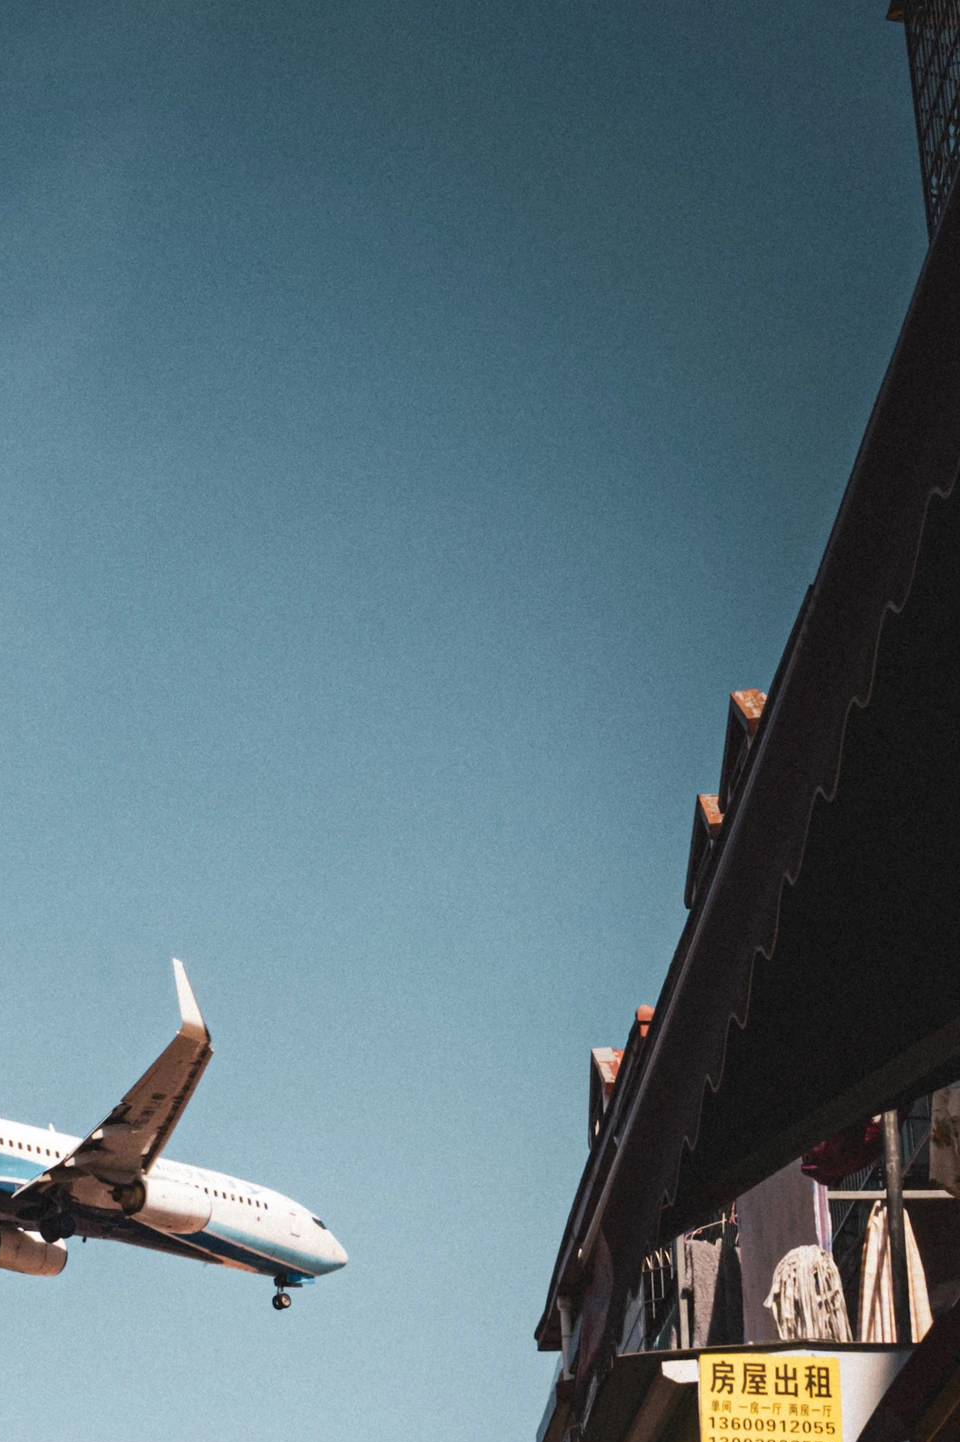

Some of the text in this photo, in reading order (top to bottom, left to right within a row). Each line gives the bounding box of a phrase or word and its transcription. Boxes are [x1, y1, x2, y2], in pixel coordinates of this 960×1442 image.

[710, 1360, 833, 1399] 房屋出租
[711, 1400, 833, 1418] 单间 一房一厅 两房一厅
[708, 1416, 836, 1435] 13600912055
